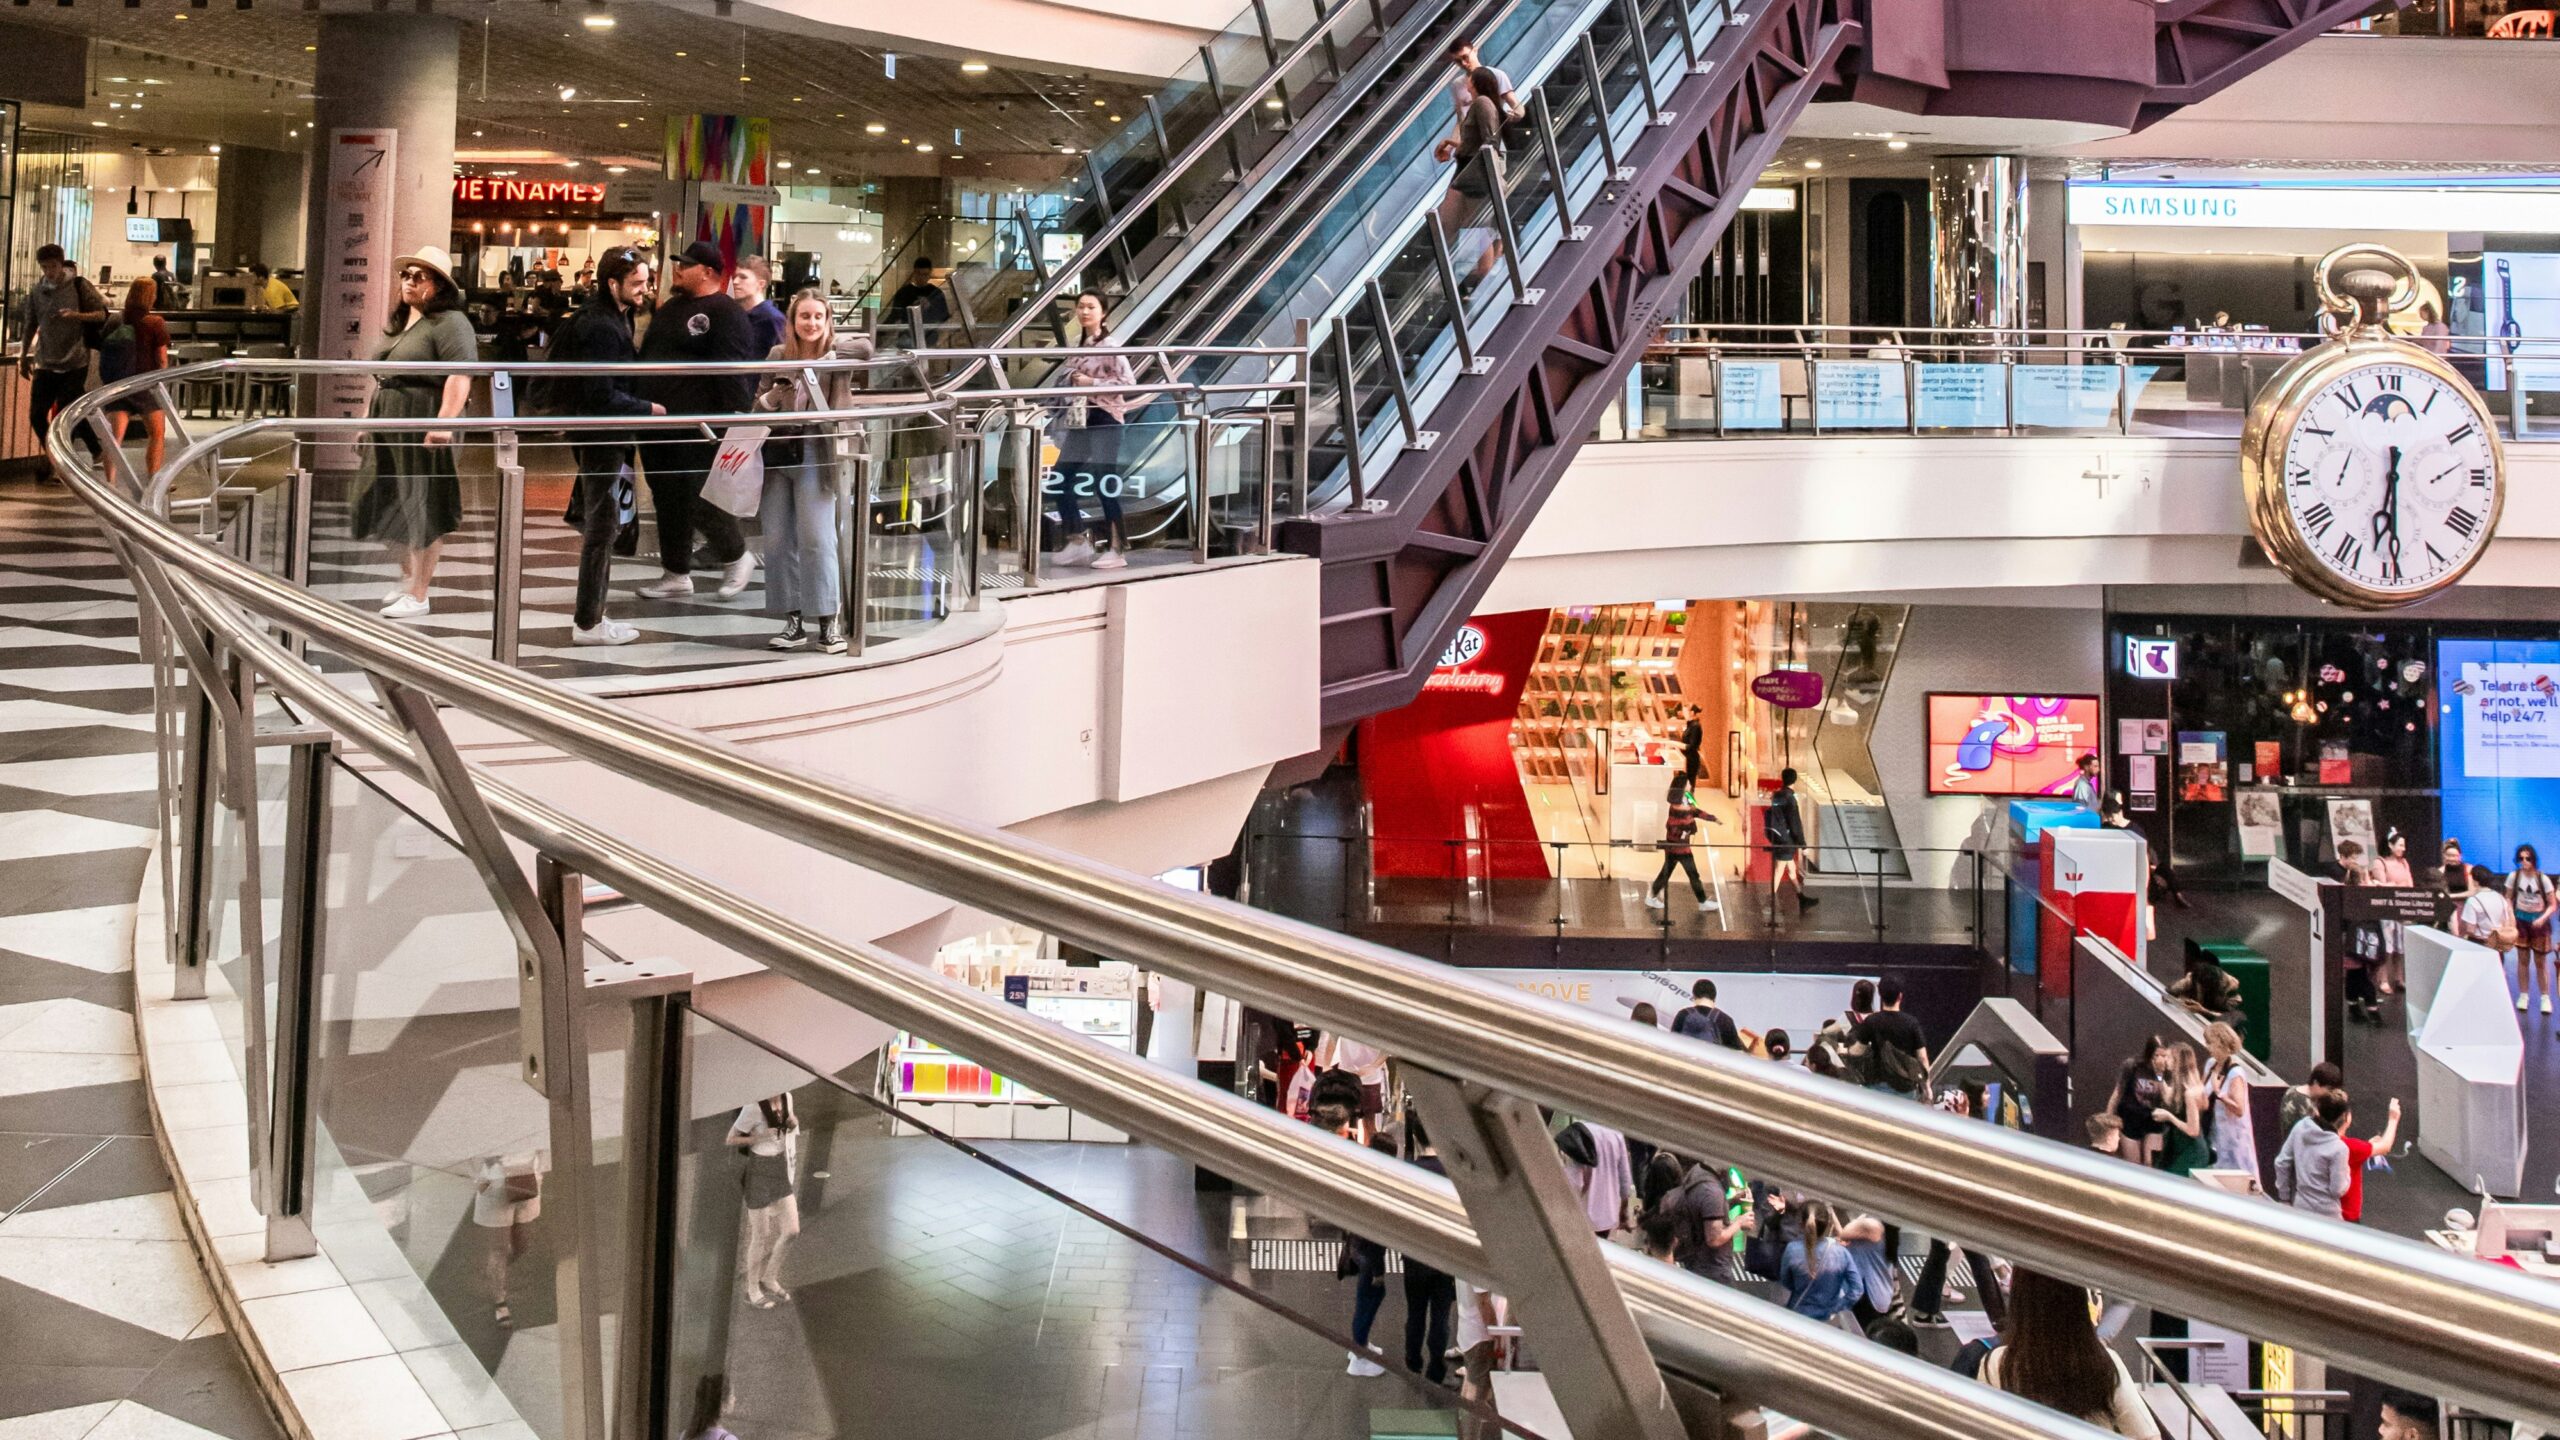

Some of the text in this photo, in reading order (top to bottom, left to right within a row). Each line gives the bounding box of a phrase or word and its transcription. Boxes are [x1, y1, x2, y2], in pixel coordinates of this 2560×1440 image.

[2105, 196, 2237, 216] SAMSUNG
[2304, 415, 2336, 445] X
[2445, 422, 2474, 446] II
[715, 445, 751, 477] H&M
[2470, 468, 2486, 488] III
[1758, 677, 1780, 685] HAVE
[2480, 680, 2527, 692] Teltra
[2498, 697, 2525, 708] not,
[2528, 697, 2559, 707] we'll
[2482, 710, 2547, 723] help 24/7.
[2411, 900, 2434, 909] Library
